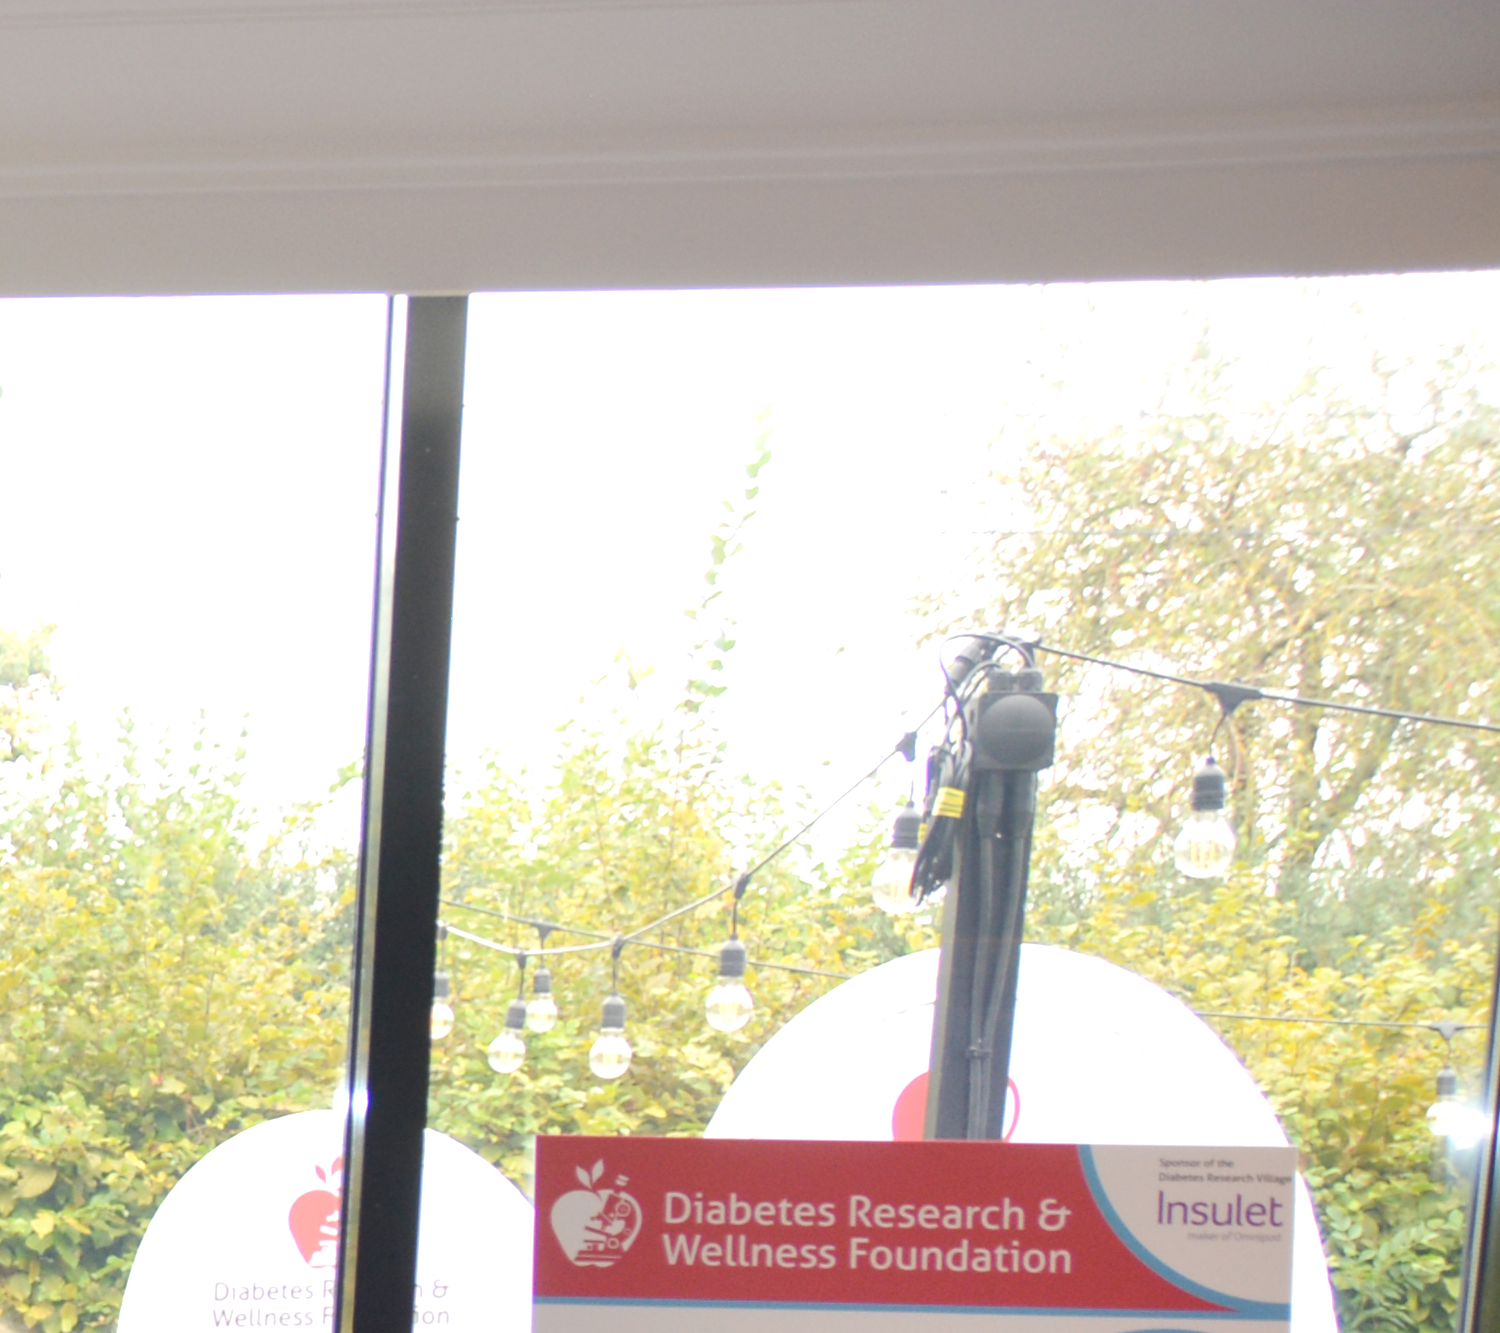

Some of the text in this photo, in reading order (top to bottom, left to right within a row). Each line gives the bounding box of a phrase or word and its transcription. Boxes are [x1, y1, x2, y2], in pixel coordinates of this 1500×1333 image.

[664, 1191, 1072, 1231] Diabetes Research &
[1157, 1190, 1282, 1227] Insulet
[662, 1233, 1071, 1273] Wellness Foundation
[214, 1282, 313, 1301] Diabetes
[212, 1308, 313, 1327] Wellness
